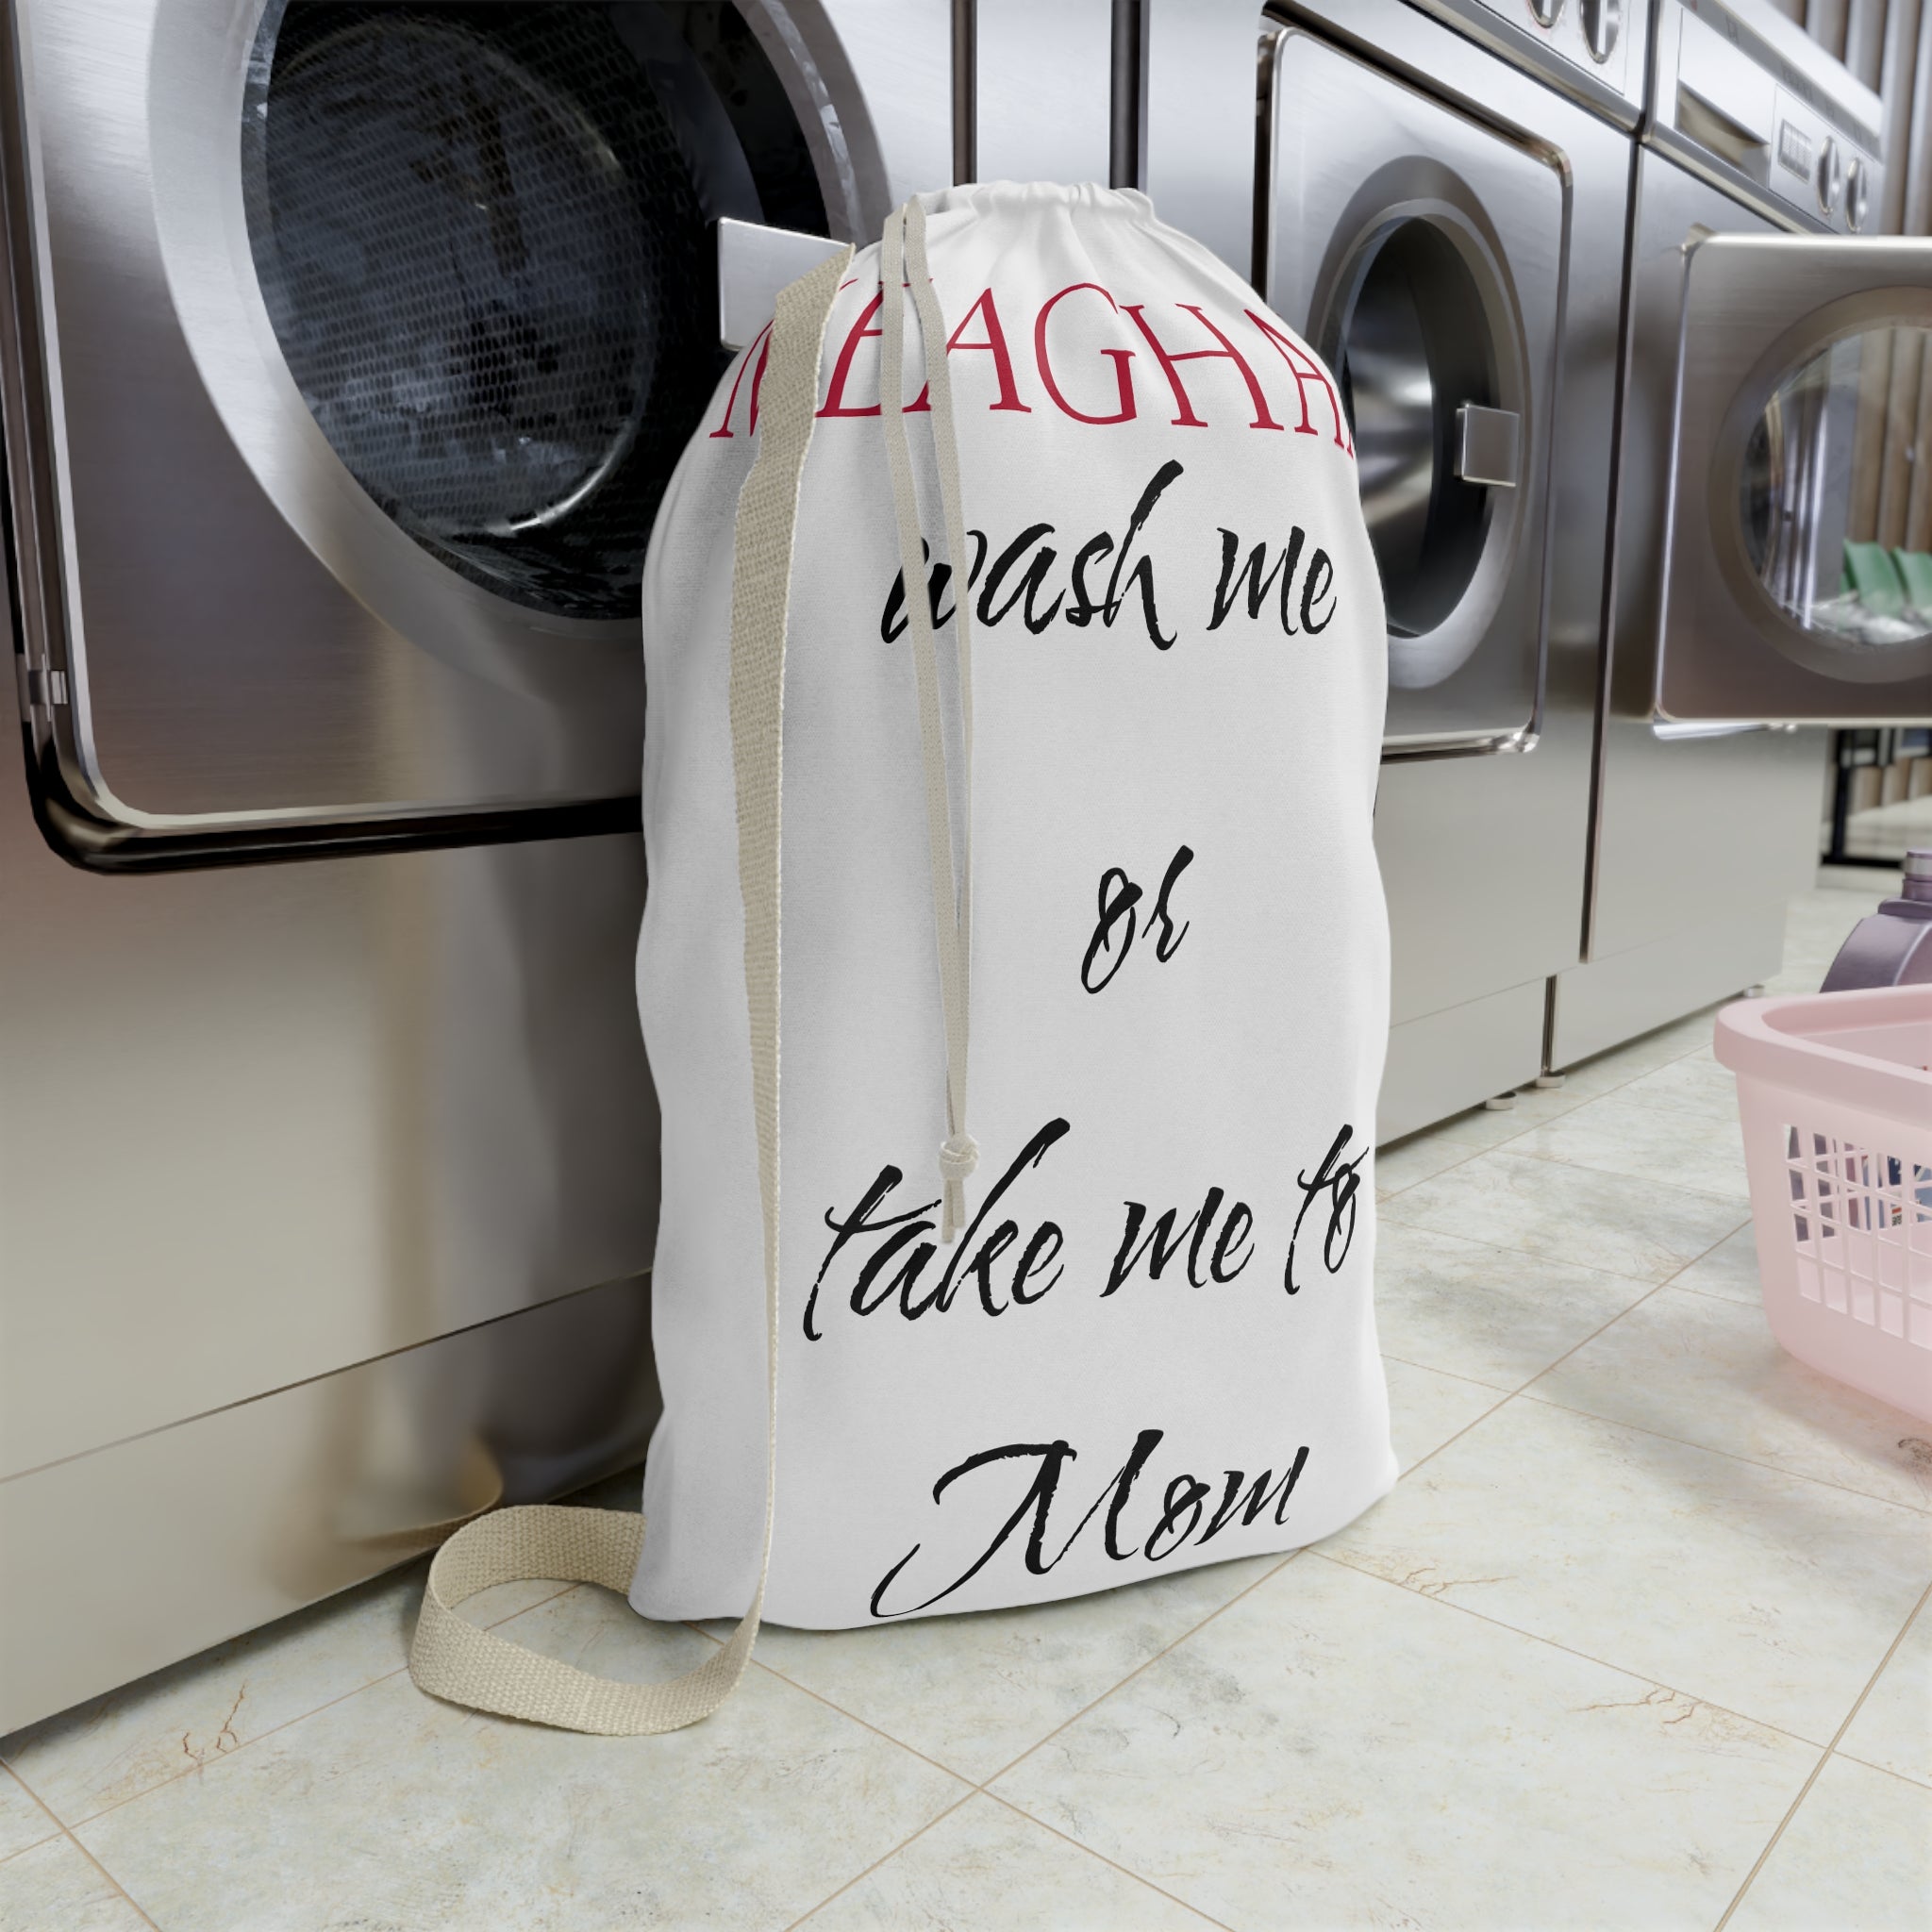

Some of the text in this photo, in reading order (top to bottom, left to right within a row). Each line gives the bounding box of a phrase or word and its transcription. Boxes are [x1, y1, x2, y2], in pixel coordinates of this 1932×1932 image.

[708, 278, 1355, 459] EAGHA
[880, 459, 1338, 651] wash me
[1080, 844, 1195, 994] or
[803, 1117, 1370, 1341] take me to
[870, 1429, 1310, 1617] Mom
